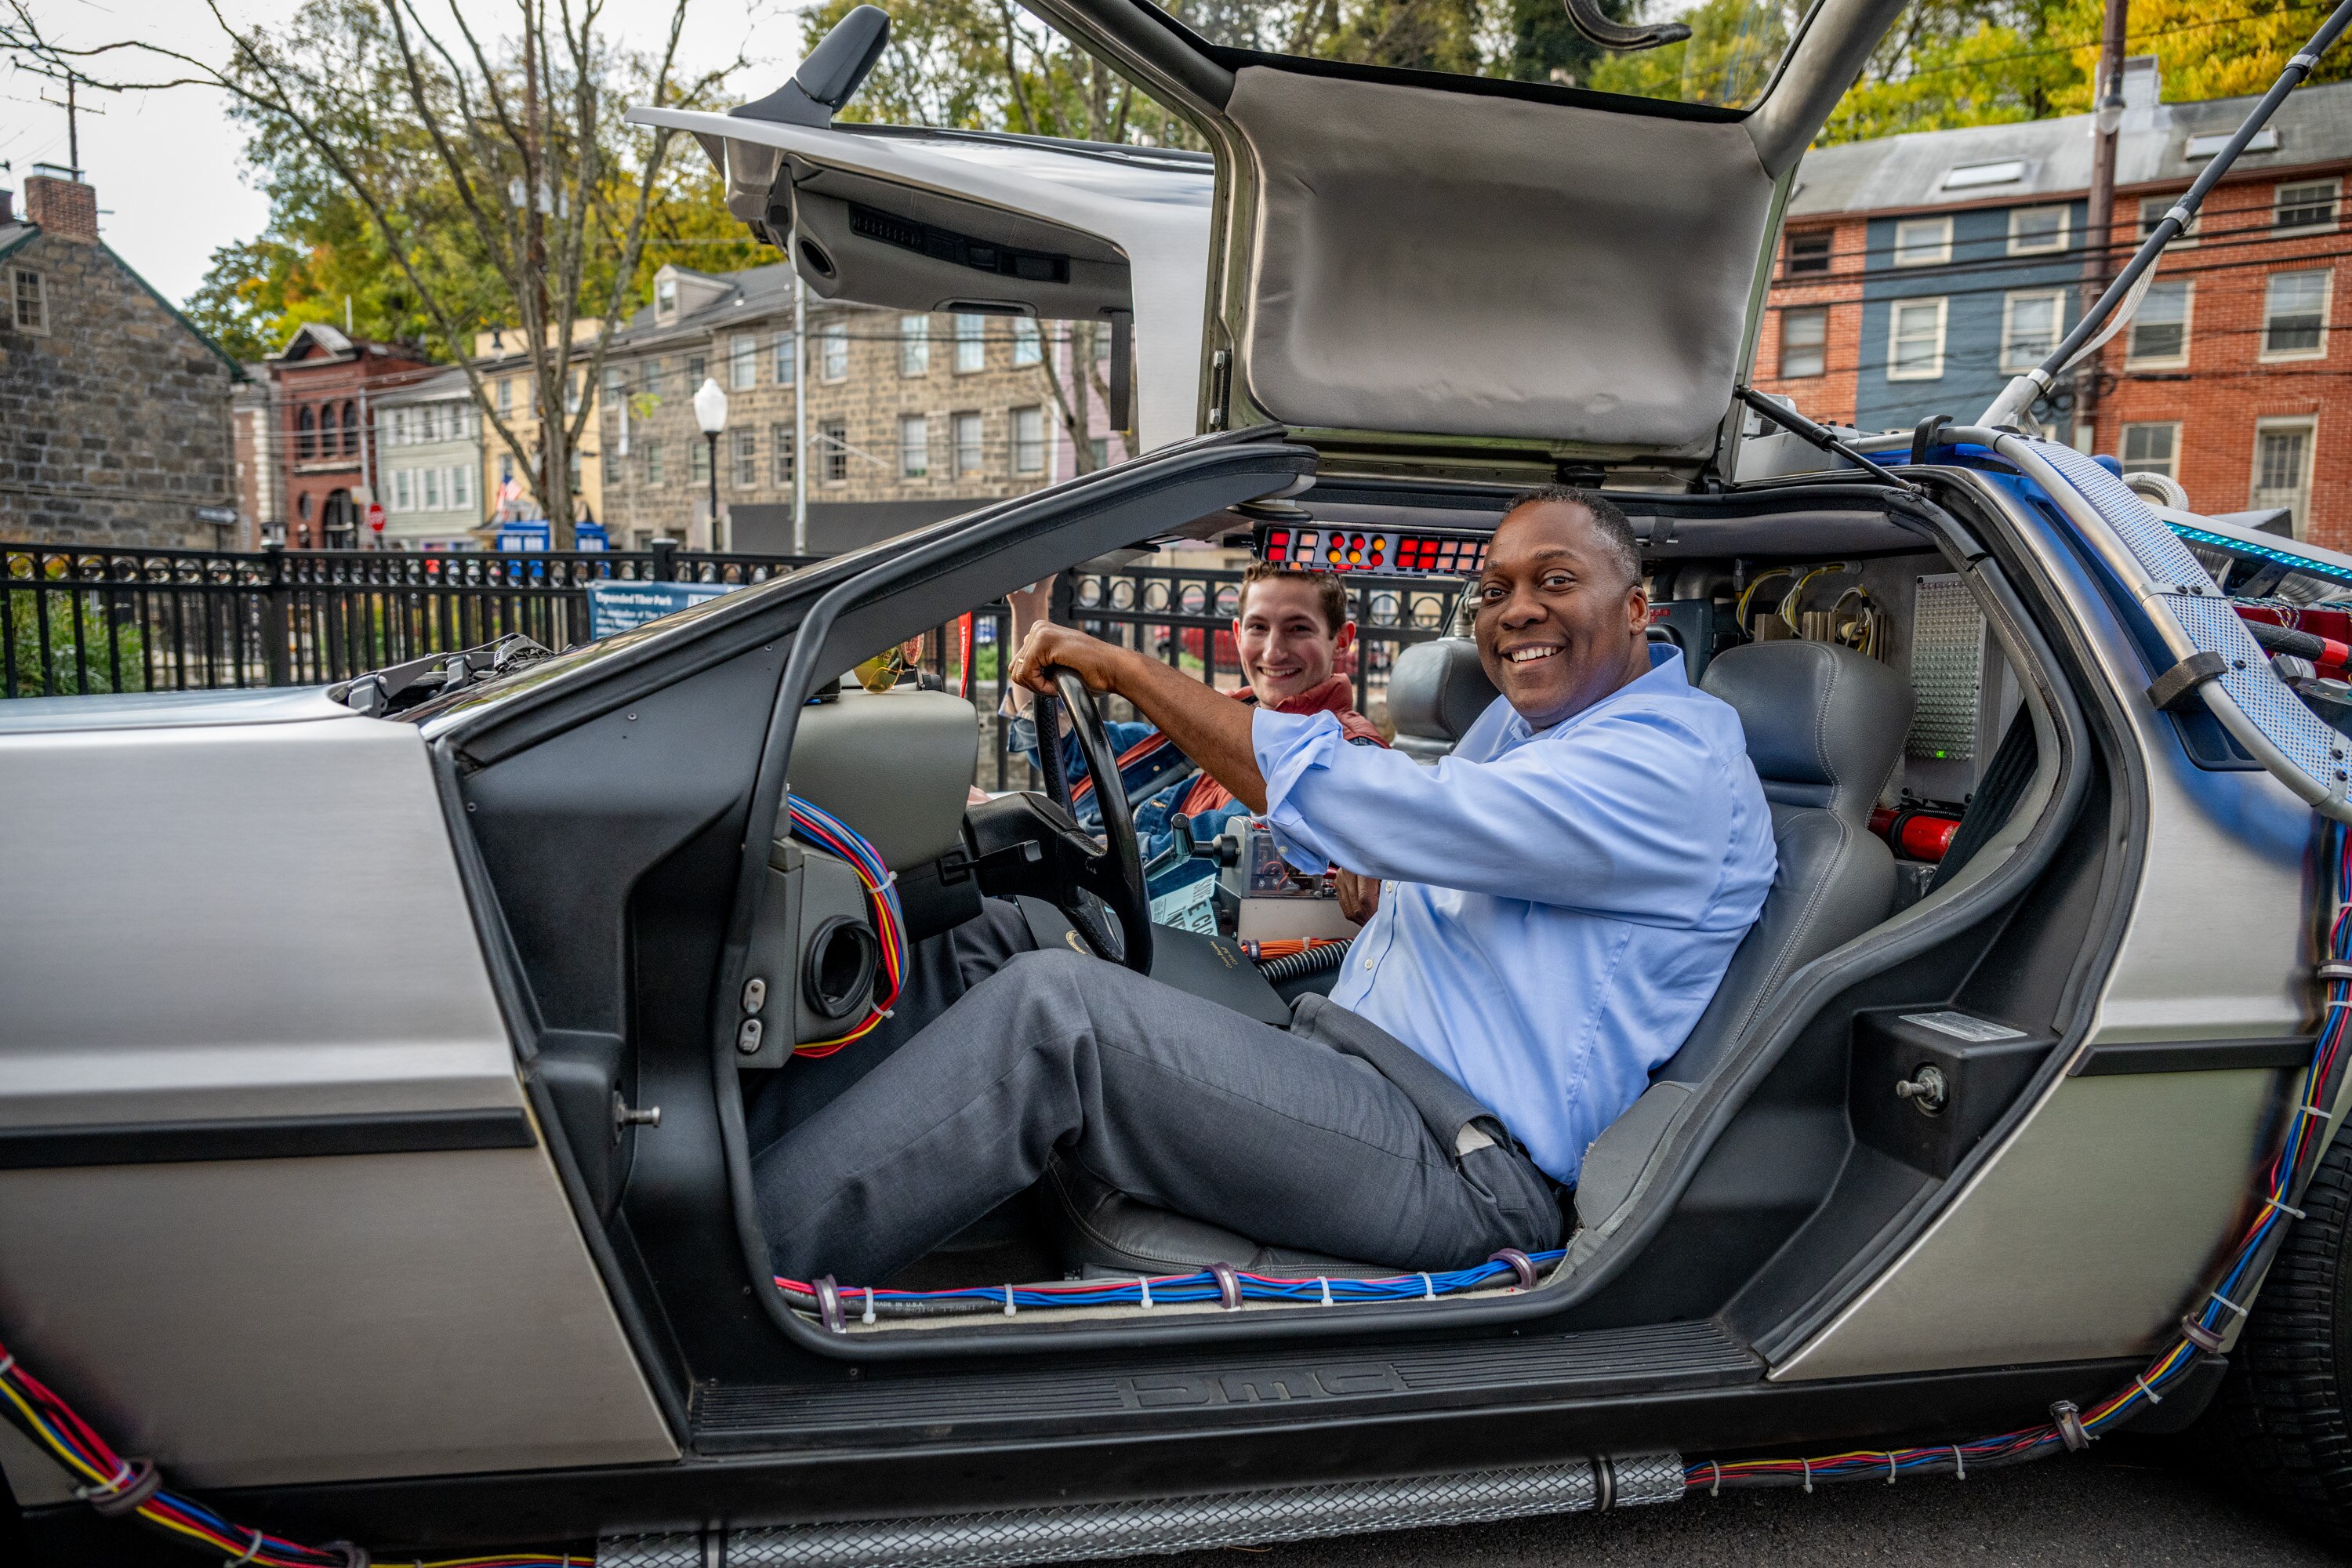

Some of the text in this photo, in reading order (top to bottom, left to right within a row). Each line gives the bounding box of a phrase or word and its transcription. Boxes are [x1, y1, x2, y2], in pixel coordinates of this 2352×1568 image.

[635, 593, 653, 605] Tiber
[654, 594, 672, 606] Park
[1192, 878, 1212, 902] SAVE
[1131, 1364, 1394, 1407] DMC
